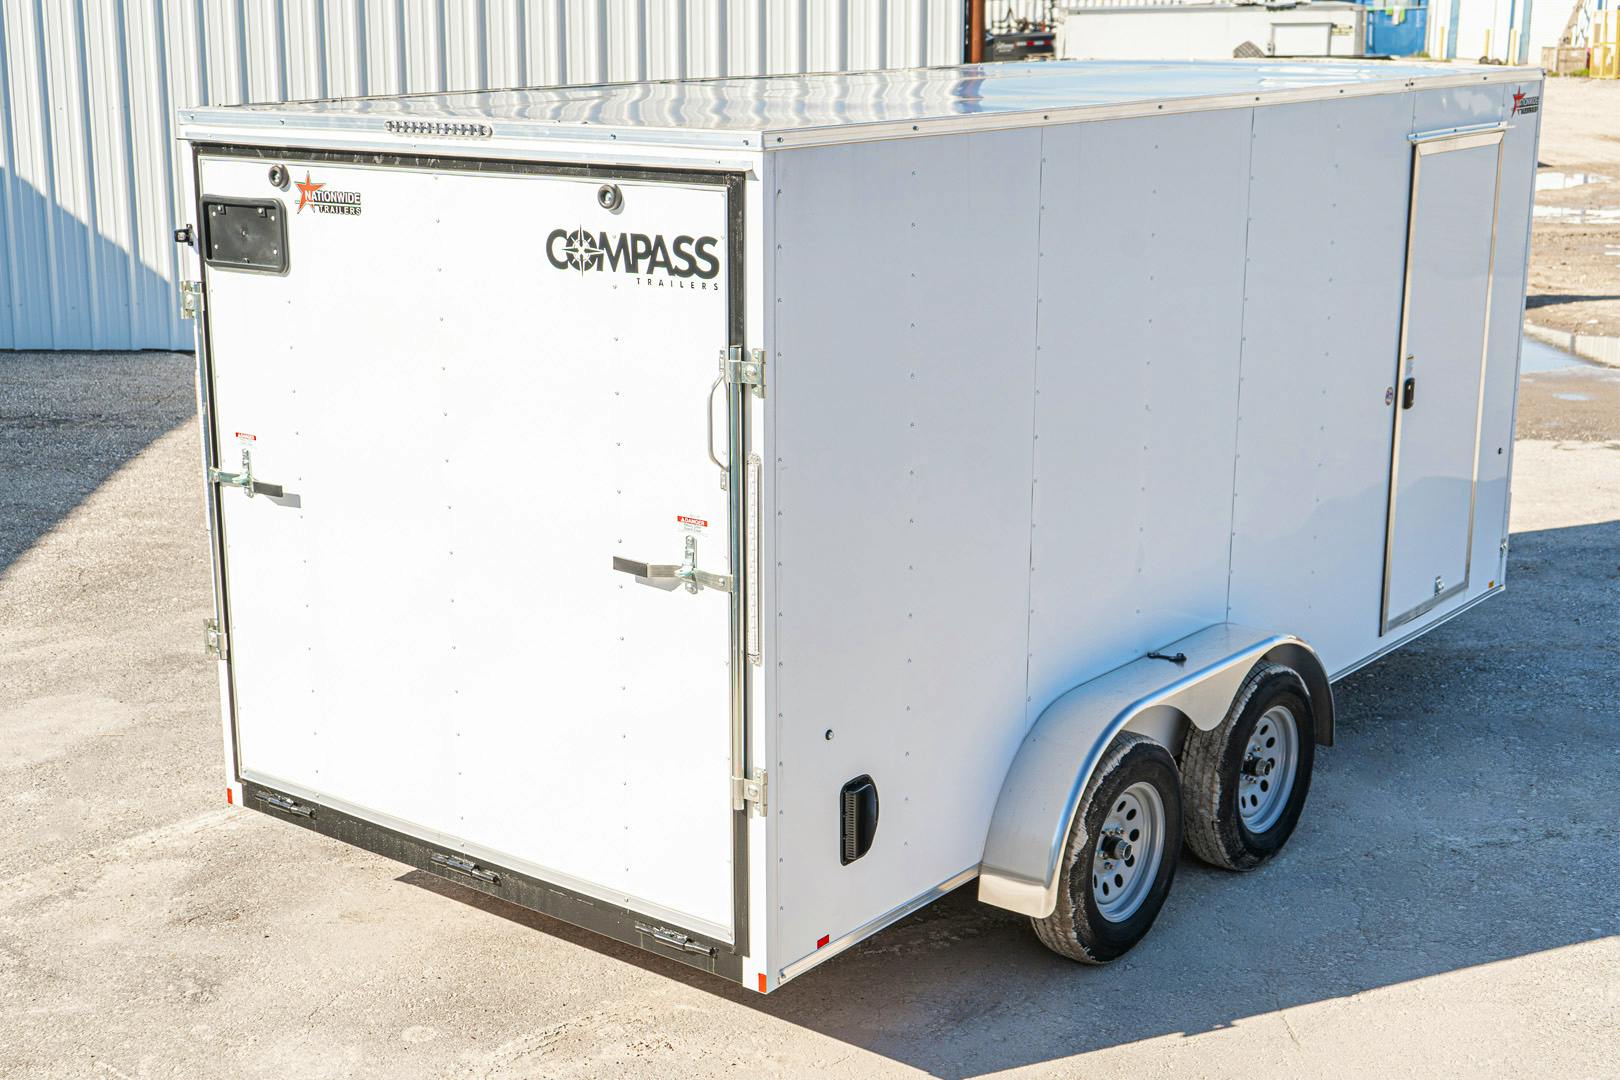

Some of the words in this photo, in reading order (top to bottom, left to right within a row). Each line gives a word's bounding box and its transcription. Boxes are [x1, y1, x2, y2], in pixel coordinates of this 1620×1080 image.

[304, 189, 361, 204] NATIONWIDE
[319, 205, 361, 216] TRAILERS
[546, 227, 720, 280] COMPASS
[636, 277, 719, 291] TRAILERS
